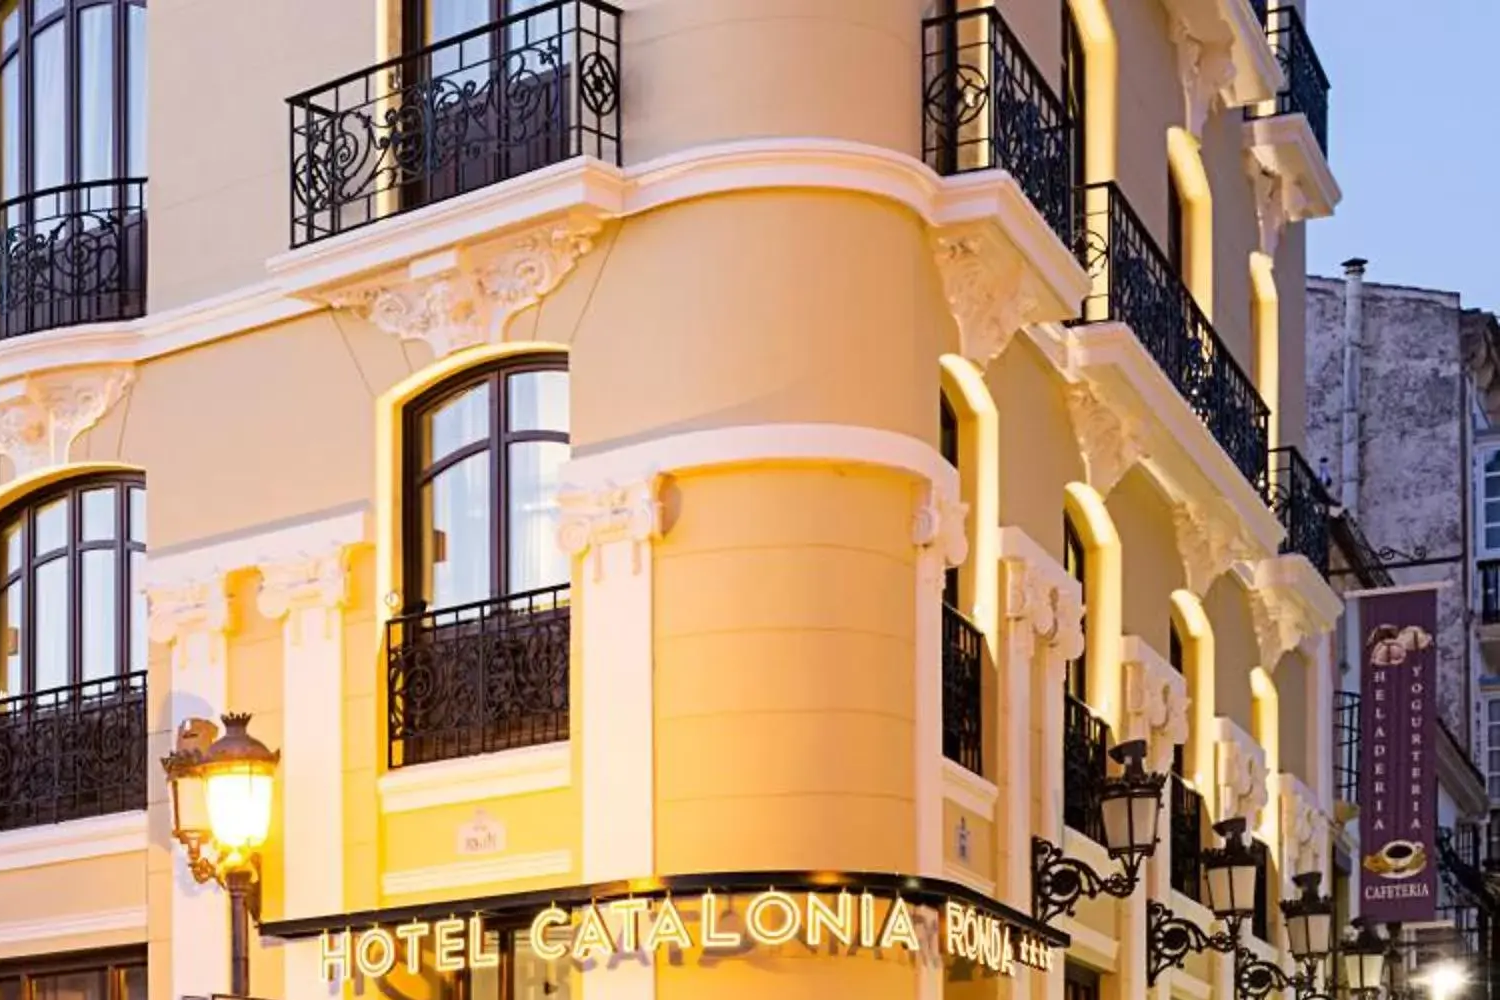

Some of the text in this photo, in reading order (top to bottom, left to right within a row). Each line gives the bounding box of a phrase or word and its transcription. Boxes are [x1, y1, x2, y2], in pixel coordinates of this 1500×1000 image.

[1372, 670, 1386, 831] HELADERIA
[1409, 665, 1423, 830] YOGURTERIA
[320, 890, 1017, 982] HOTEL CATALONIA RONDA
[1365, 883, 1429, 900] CAFETERIA
